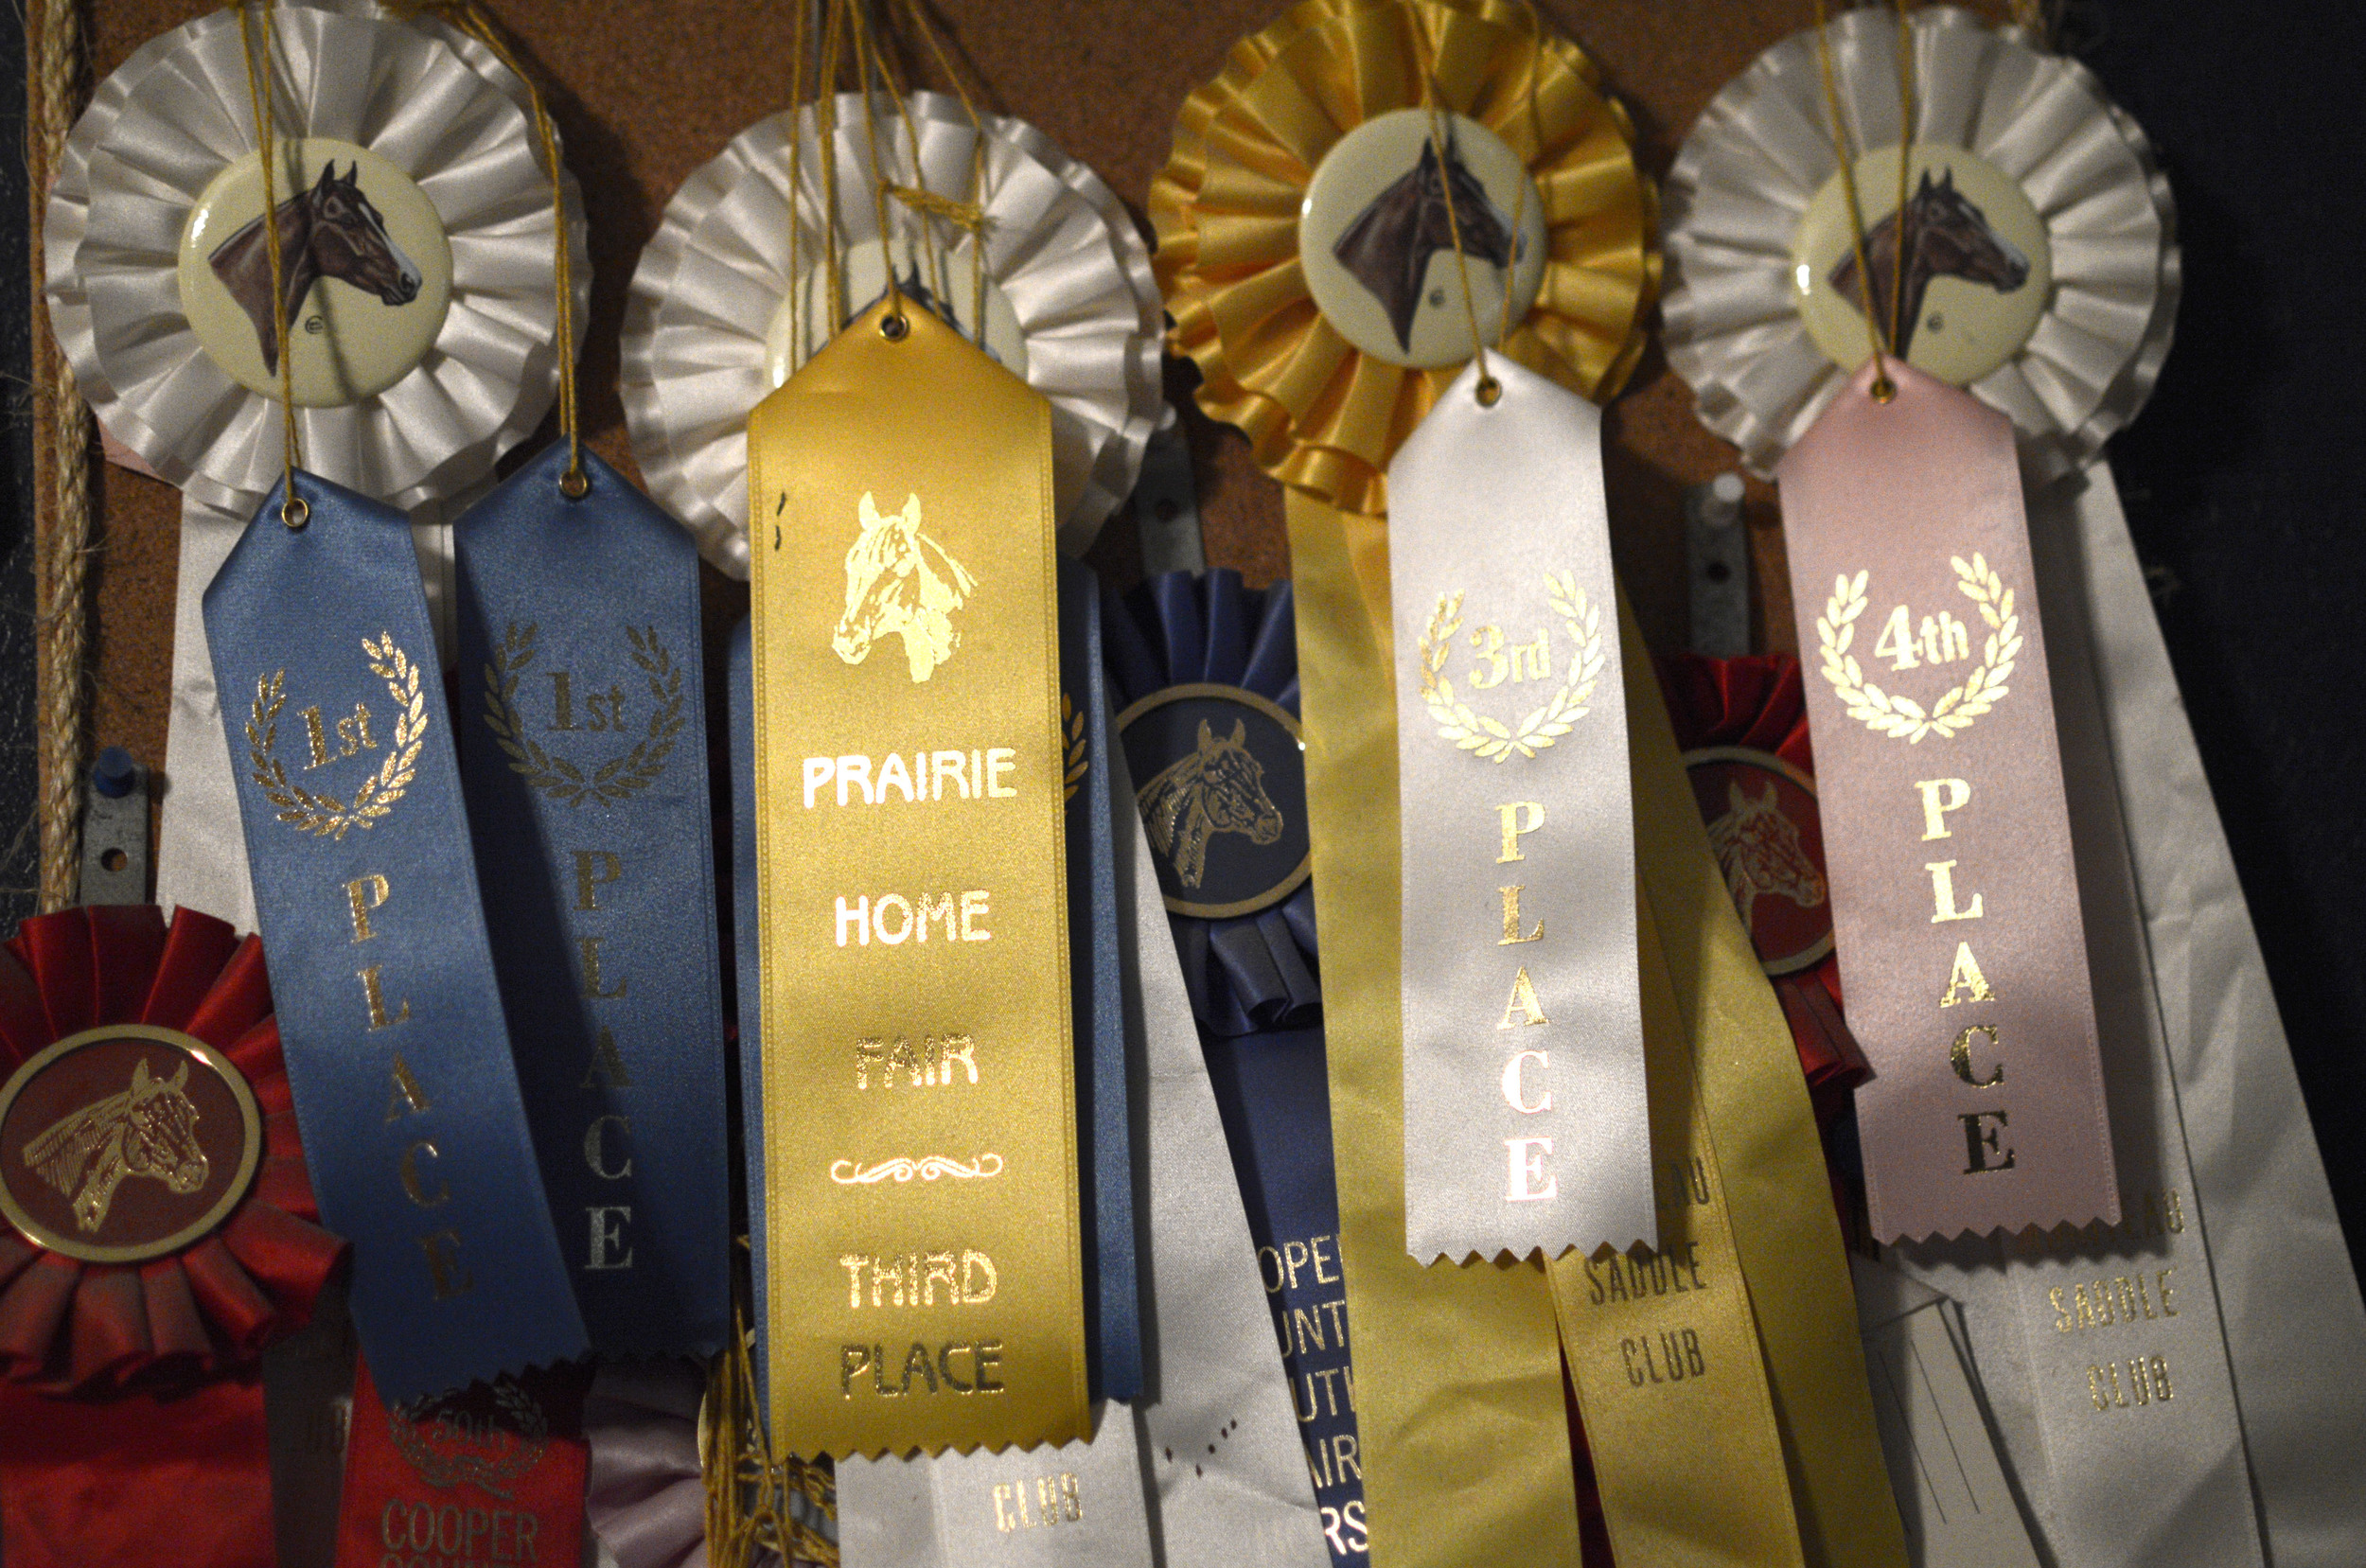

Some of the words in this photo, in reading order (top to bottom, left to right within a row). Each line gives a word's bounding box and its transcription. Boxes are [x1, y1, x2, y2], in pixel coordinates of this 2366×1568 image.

[1468, 625, 1550, 689] 3rd
[1874, 605, 1969, 672] 4th
[545, 671, 627, 733] 1st
[295, 701, 378, 770] 1st
[803, 747, 1018, 809] PRAIRIE
[835, 889, 992, 947] HOME
[1494, 799, 1558, 1203] PLACE
[1914, 776, 2016, 1176] PLACE
[342, 872, 472, 1301] PLACE
[569, 849, 633, 1270] PLACE
[856, 1033, 980, 1090] FAIR
[839, 1248, 998, 1309] THIRD
[1258, 1234, 1344, 1294] OPE
[1583, 1241, 1707, 1307] SADDLE
[2049, 1269, 2180, 1334] SADDLE
[840, 1339, 1005, 1401] PLACE
[1620, 1328, 1704, 1388] CLUB
[2086, 1355, 2174, 1412] CLUB
[381, 1497, 539, 1563] COOPER
[993, 1472, 1083, 1533] CLUB
